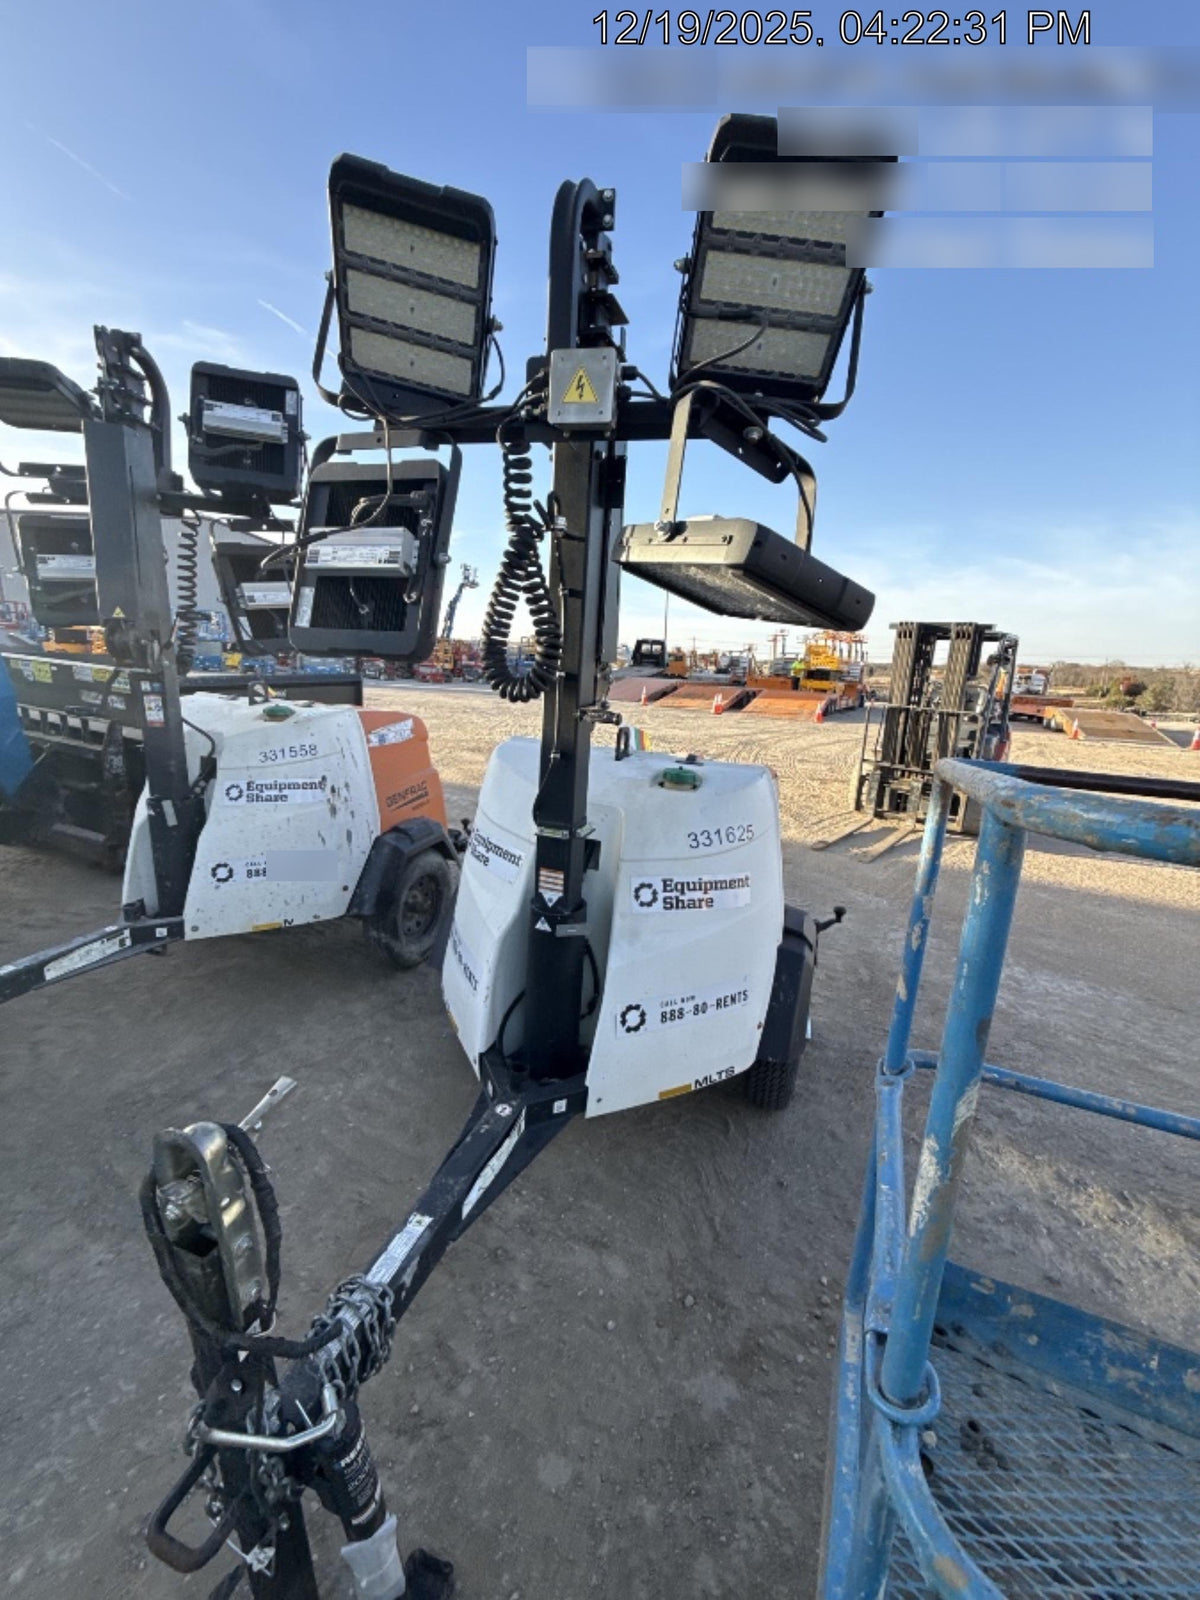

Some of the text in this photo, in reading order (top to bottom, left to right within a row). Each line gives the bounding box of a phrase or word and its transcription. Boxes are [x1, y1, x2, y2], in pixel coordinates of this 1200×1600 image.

[259, 744, 318, 763] 331558
[246, 780, 326, 793] Equipment
[246, 792, 288, 802] Share
[687, 824, 755, 849] 331625
[661, 875, 750, 895] Equipment
[662, 895, 714, 911] Share
[660, 989, 749, 1024] 888-80-RENTS
